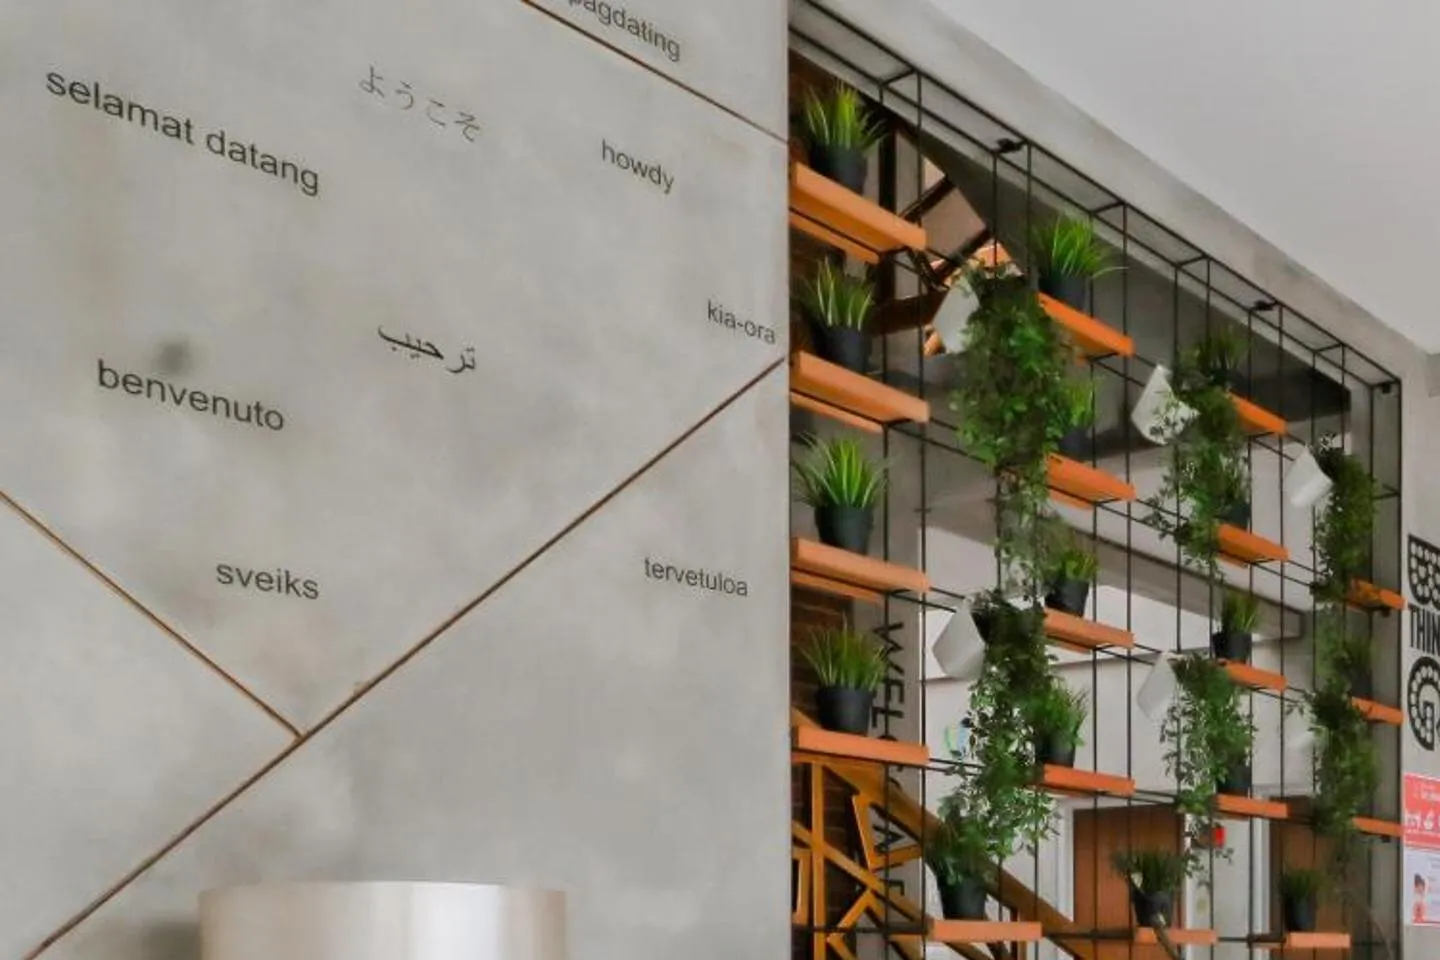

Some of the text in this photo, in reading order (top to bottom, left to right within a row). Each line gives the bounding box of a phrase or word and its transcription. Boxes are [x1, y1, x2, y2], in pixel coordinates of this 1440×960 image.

[358, 65, 482, 143] ようこそ
[45, 70, 321, 197] selamat datang
[601, 138, 675, 195] howdy
[706, 299, 776, 345] kia-ora
[377, 325, 477, 374] ترحيب
[98, 359, 285, 432] benvenuto
[215, 563, 320, 600] sveiks
[643, 556, 749, 598] tervetuloa
